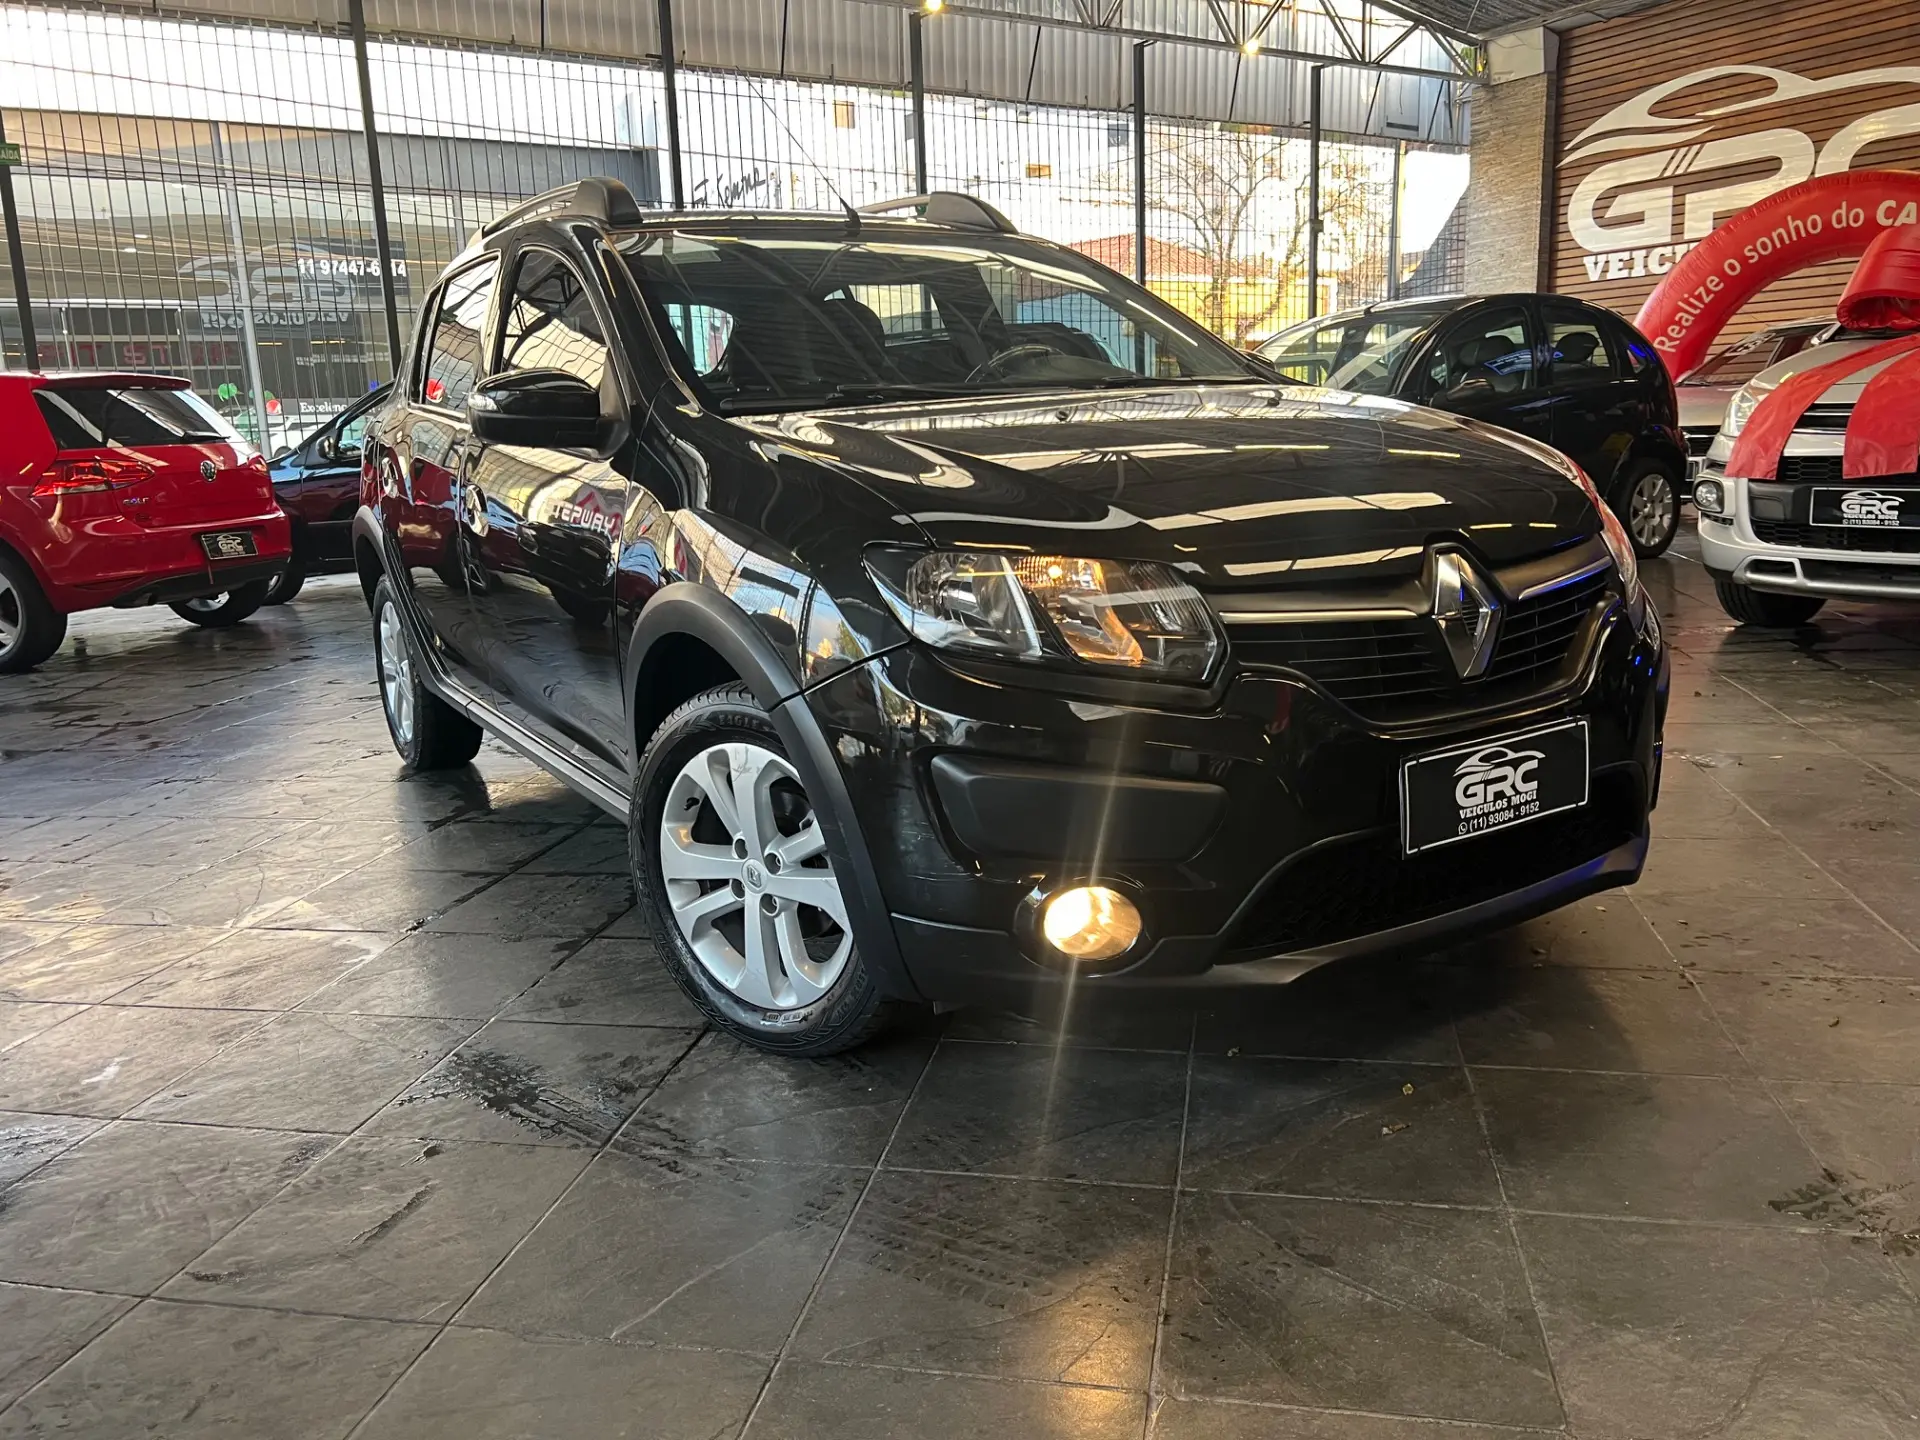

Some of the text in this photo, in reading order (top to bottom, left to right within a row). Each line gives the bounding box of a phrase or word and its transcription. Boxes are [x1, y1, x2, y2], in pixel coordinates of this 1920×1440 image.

[320, 259, 407, 277] 97447-614
[1654, 273, 1725, 354] Realize
[1726, 257, 1742, 276] o
[1744, 211, 1822, 264] sonho
[1831, 201, 1864, 229] do
[1876, 199, 1917, 227] CA
[1841, 500, 1899, 515] GRC
[218, 540, 243, 550] GRC
[1455, 759, 1539, 807] GRC
[1459, 789, 1537, 819] VEICULOS MOGI
[1469, 816, 1487, 833] (11)
[1488, 809, 1514, 825] 93084
[1520, 801, 1540, 818] 9152
